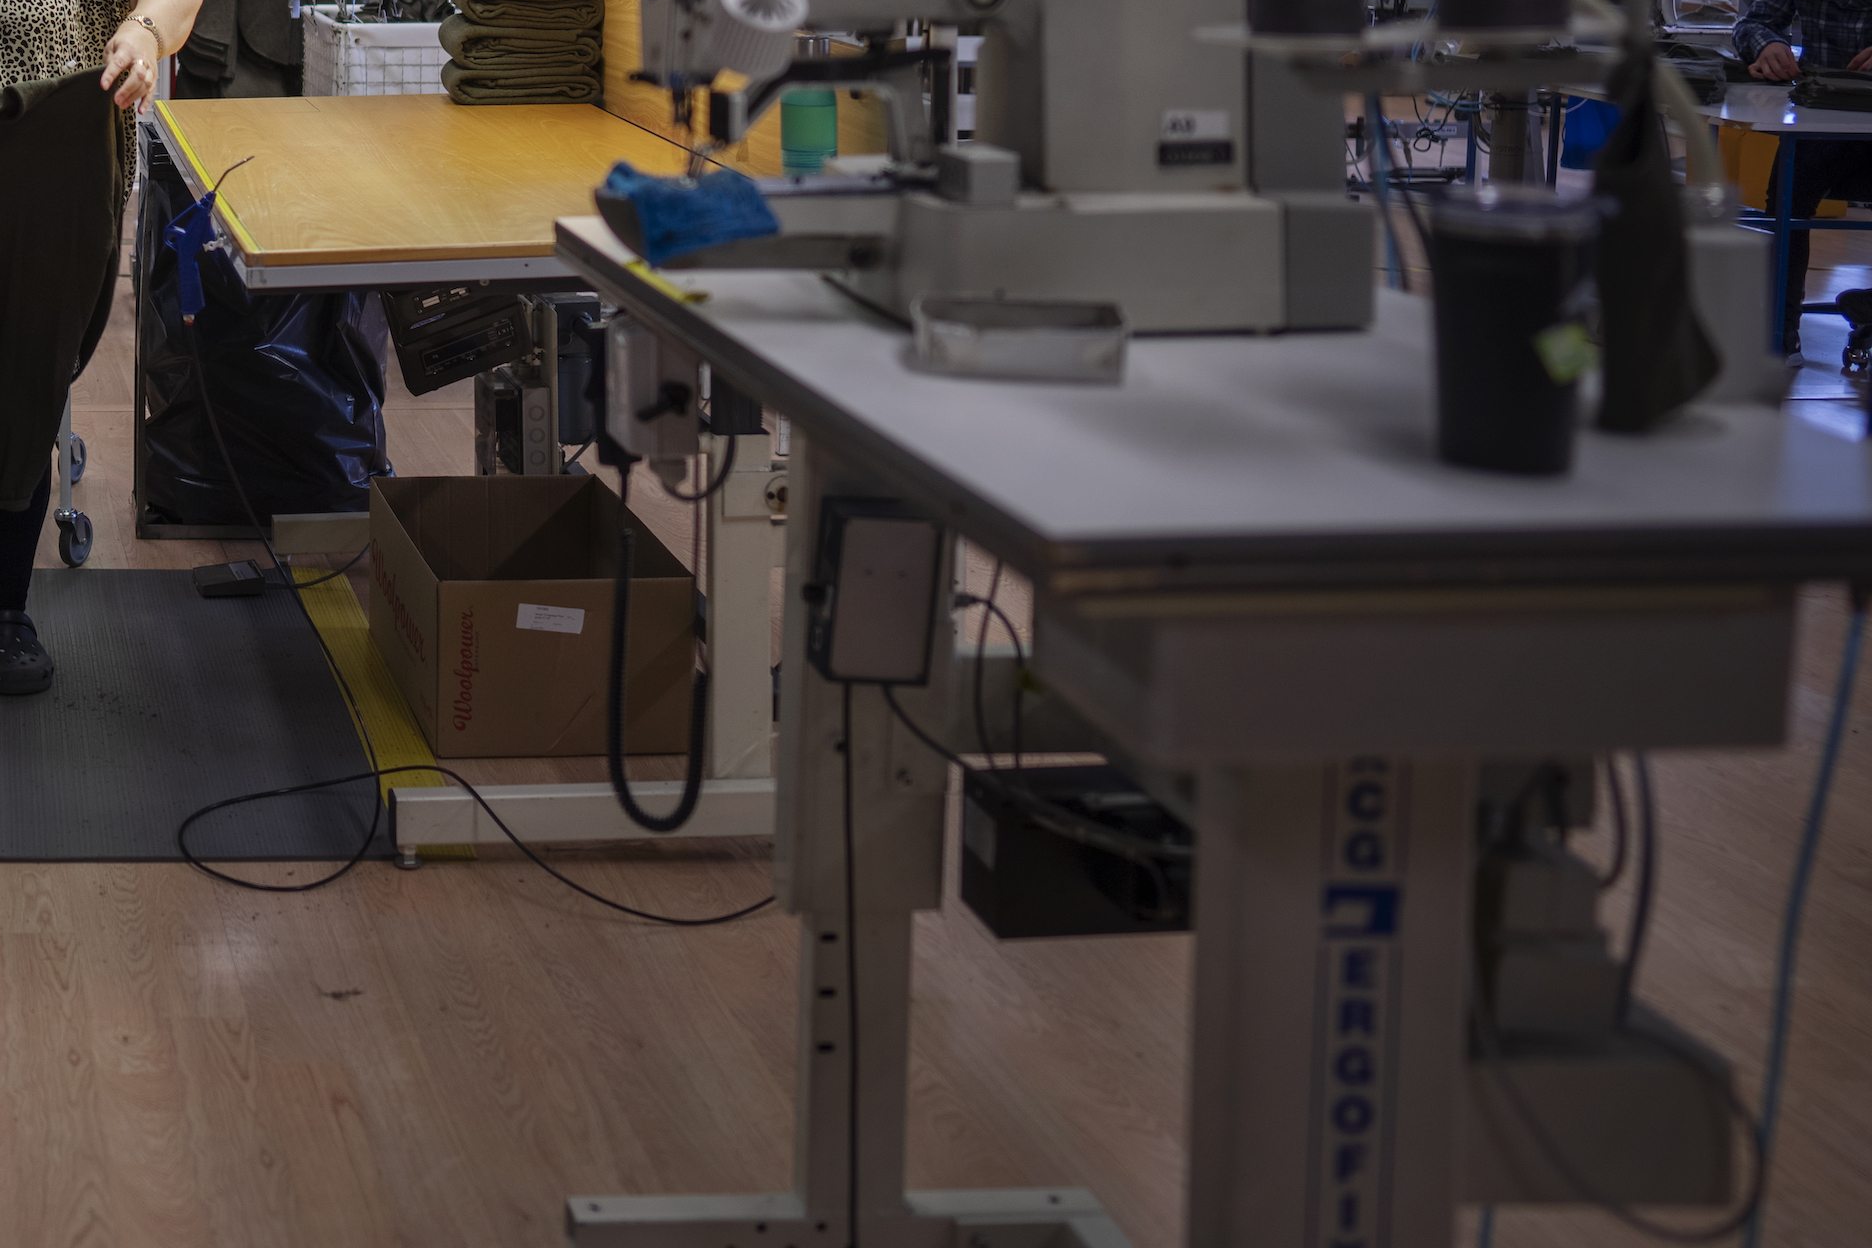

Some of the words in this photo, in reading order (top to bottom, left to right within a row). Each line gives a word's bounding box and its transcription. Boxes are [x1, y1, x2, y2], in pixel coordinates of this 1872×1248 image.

[372, 538, 426, 663] Woolpower
[452, 607, 480, 732] Woolpower
[1330, 950, 1375, 1248] ERGOFI
